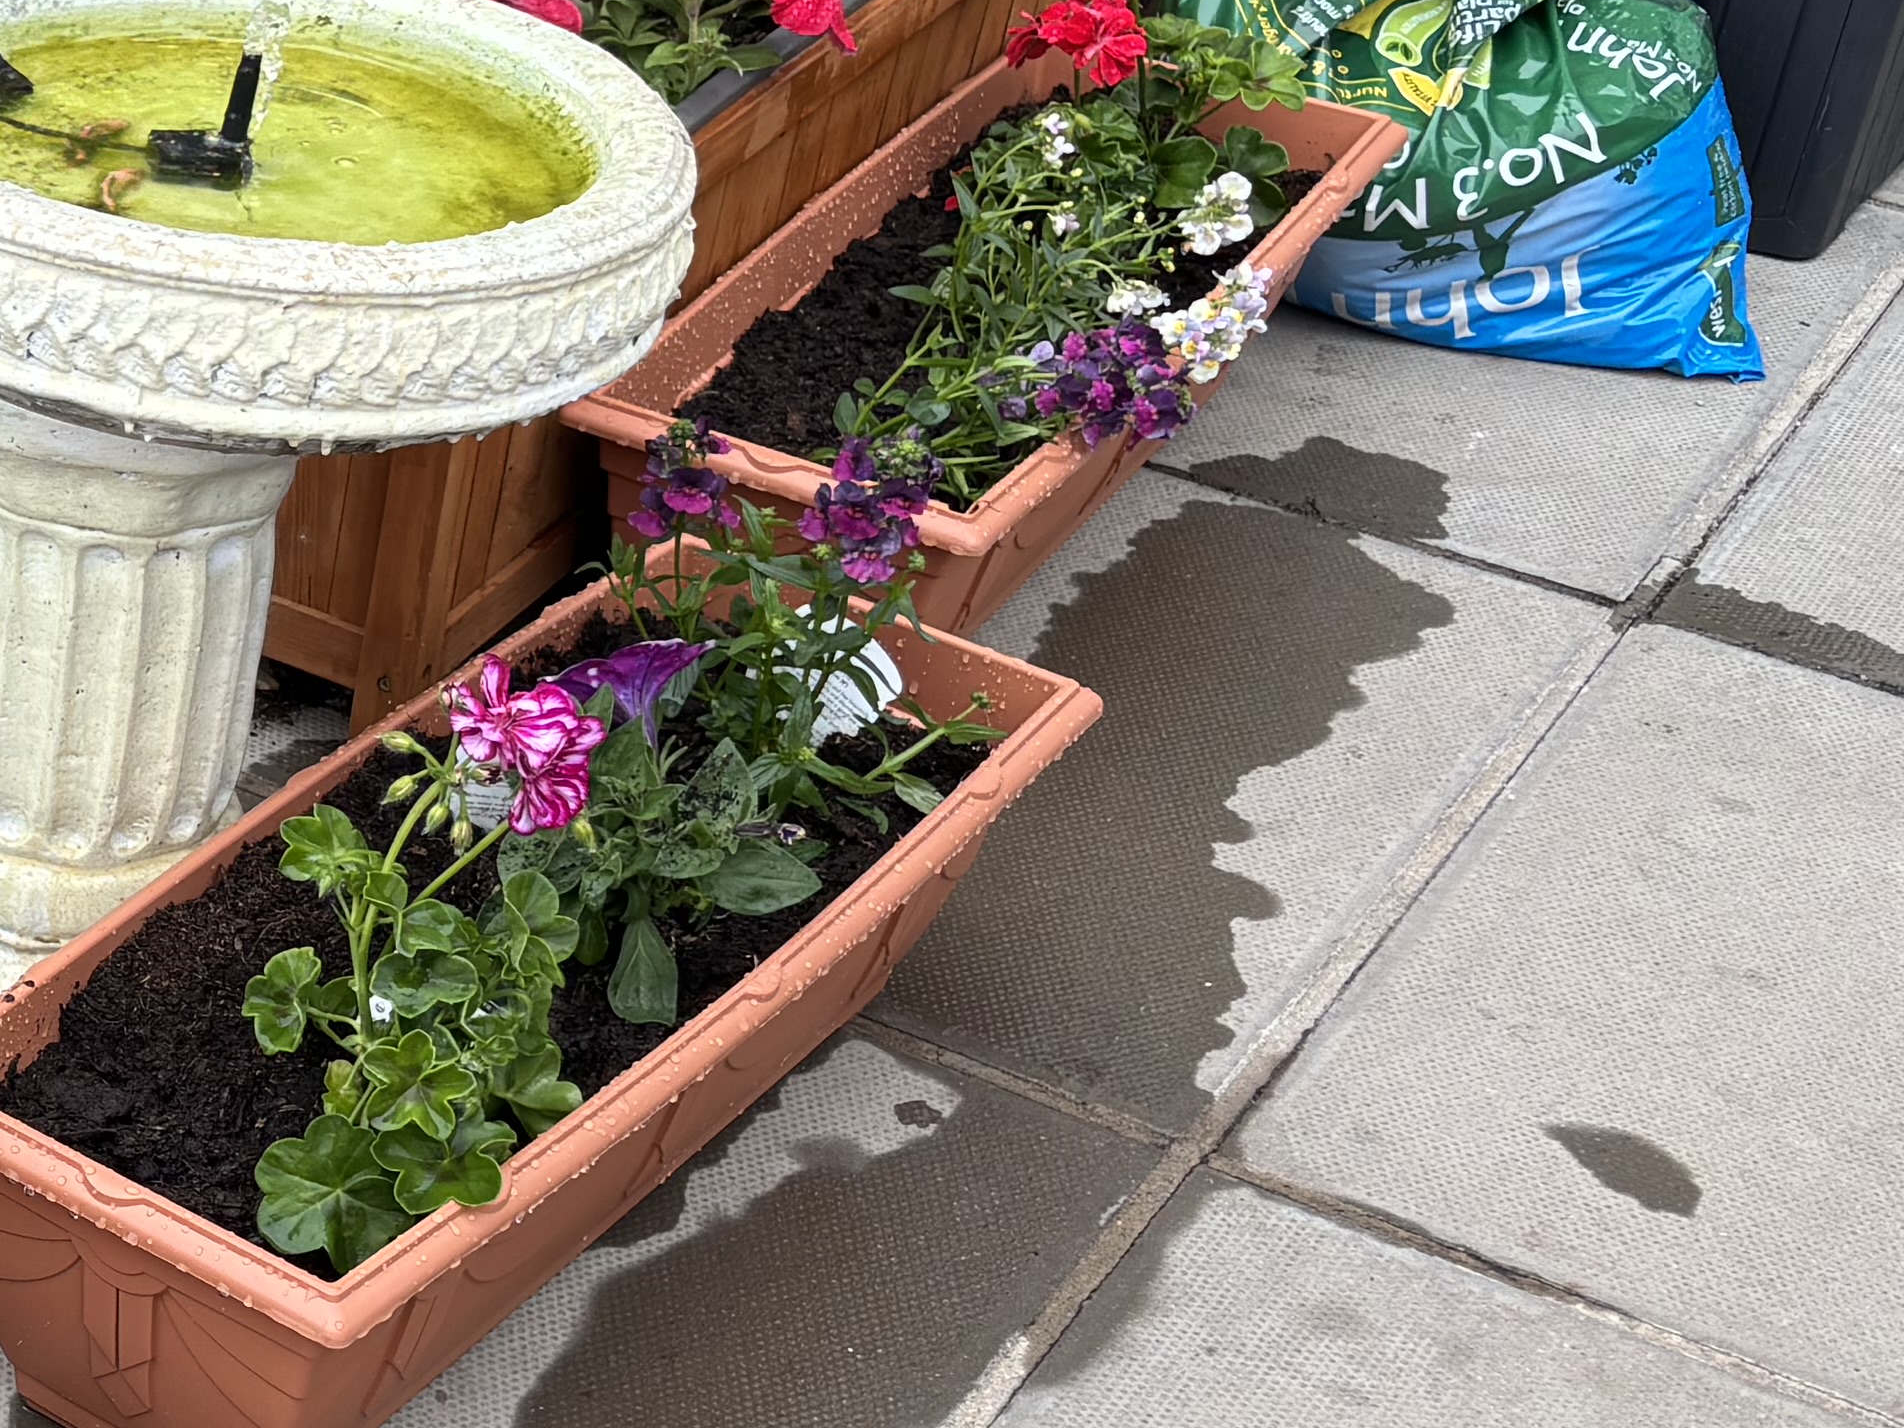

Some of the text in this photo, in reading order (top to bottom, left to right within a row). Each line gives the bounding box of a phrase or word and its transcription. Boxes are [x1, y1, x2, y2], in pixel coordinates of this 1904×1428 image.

[1566, 21, 1686, 103] John
[1452, 111, 1608, 222] No.3
[1330, 242, 1600, 340] John
